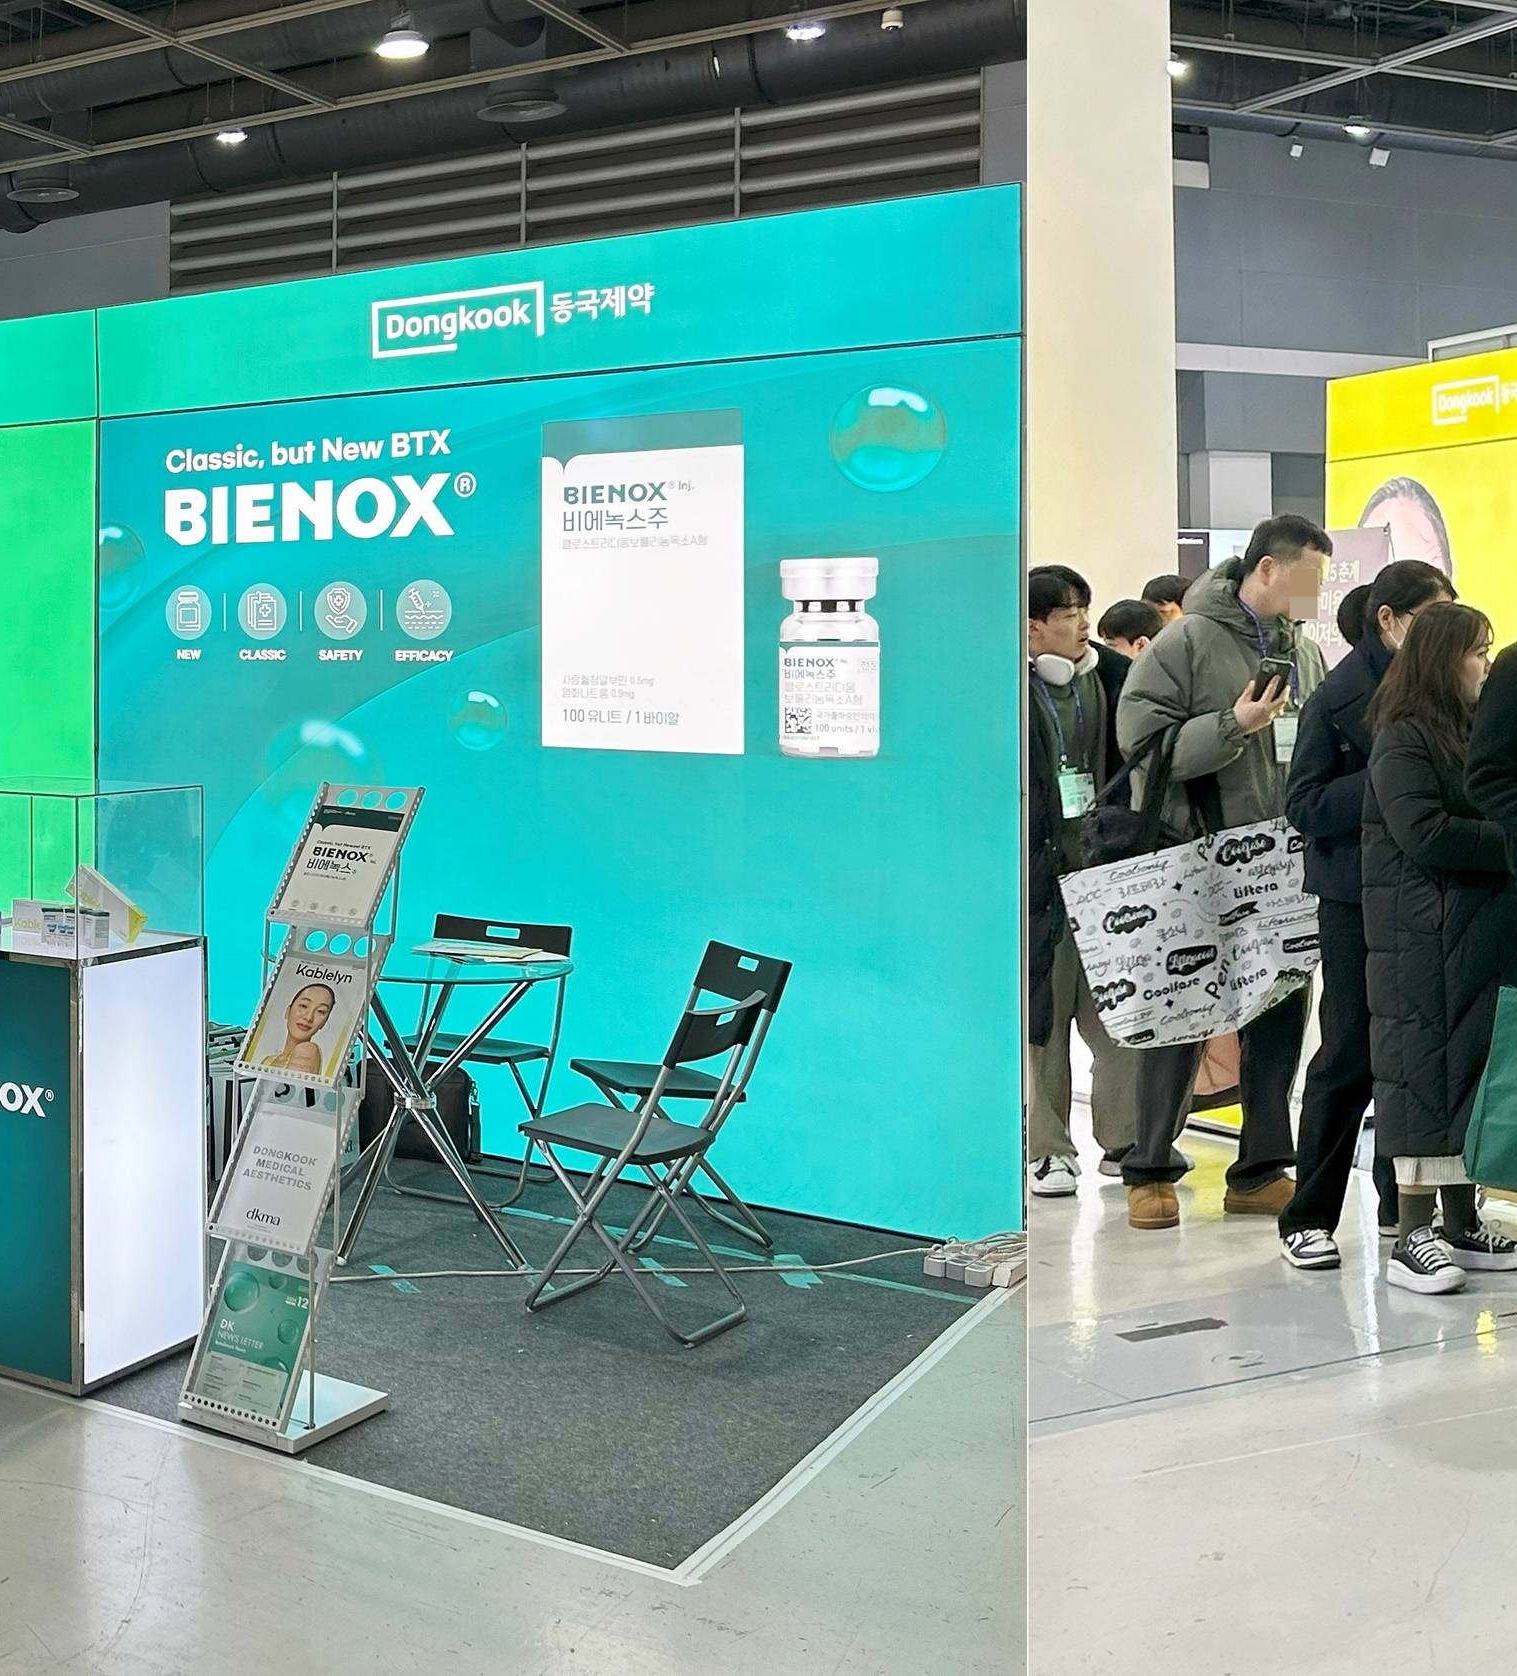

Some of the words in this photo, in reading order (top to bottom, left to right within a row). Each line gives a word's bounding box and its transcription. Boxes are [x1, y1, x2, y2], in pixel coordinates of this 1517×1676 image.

[385, 298, 533, 342] Dongkook
[550, 283, 655, 324] 동국제약
[1439, 387, 1494, 416] Dongkook
[165, 444, 265, 474] Classic,
[270, 438, 316, 467] but
[321, 433, 381, 462] New
[390, 428, 452, 457] BTX
[563, 507, 668, 532] 비에녹스주
[1338, 560, 1360, 584] 춘계
[176, 649, 202, 660] NEW
[239, 649, 287, 661] CLASSIC
[318, 649, 364, 662] SAFETY
[395, 649, 454, 662] EFFICACY
[563, 708, 585, 723] 100
[588, 709, 623, 724] 유니트
[625, 709, 632, 724] /
[635, 711, 640, 724] 1
[643, 711, 680, 726] 바이알
[312, 846, 369, 863] BIENOX
[296, 963, 353, 985] Kablelyn
[1143, 977, 1201, 1000] Coolfase
[252, 1145, 318, 1167] DONGKOOK
[255, 1158, 306, 1177] MEDICAL
[242, 1168, 313, 1191] AESTHETICS
[246, 1208, 281, 1226] dkma
[297, 1296, 310, 1309] 12
[220, 1318, 236, 1331] DK
